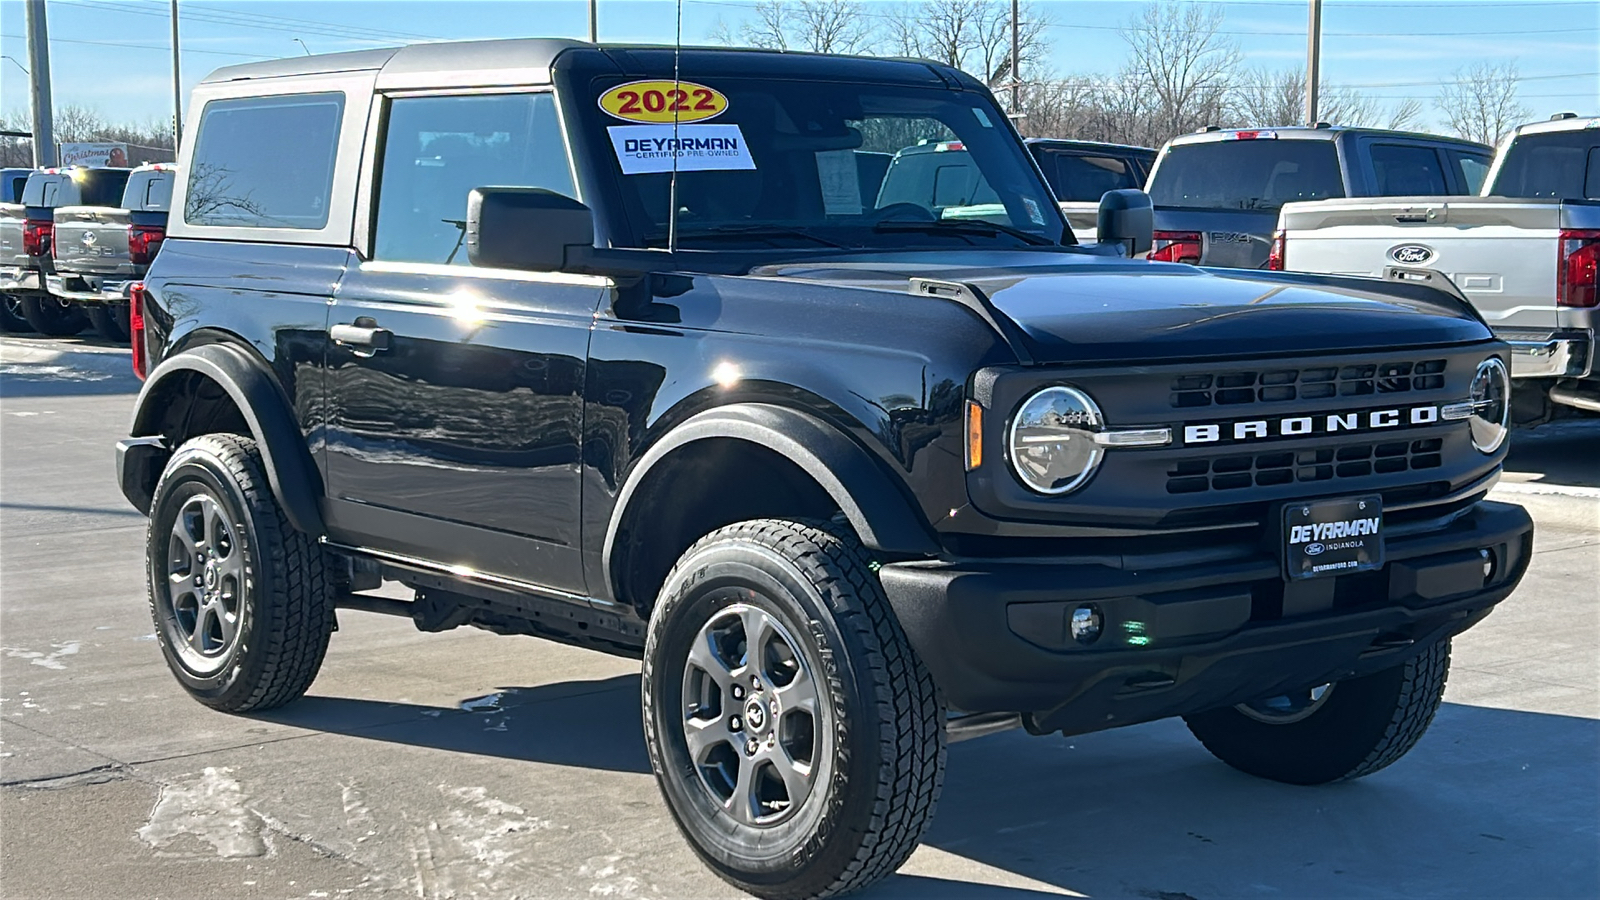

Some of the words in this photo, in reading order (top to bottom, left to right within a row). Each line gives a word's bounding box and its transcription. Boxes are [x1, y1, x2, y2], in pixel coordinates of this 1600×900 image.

[616, 89, 717, 114] 2022
[624, 138, 738, 152] DEYARMAN
[63, 149, 110, 165] Christmas
[635, 150, 685, 159] CERTIFIED
[1210, 231, 1252, 246] FX4
[1398, 247, 1426, 261] Ford
[1184, 405, 1438, 443] BRONCO
[1289, 517, 1380, 544] DEYARMAN
[1325, 540, 1364, 551] INDIANOLA
